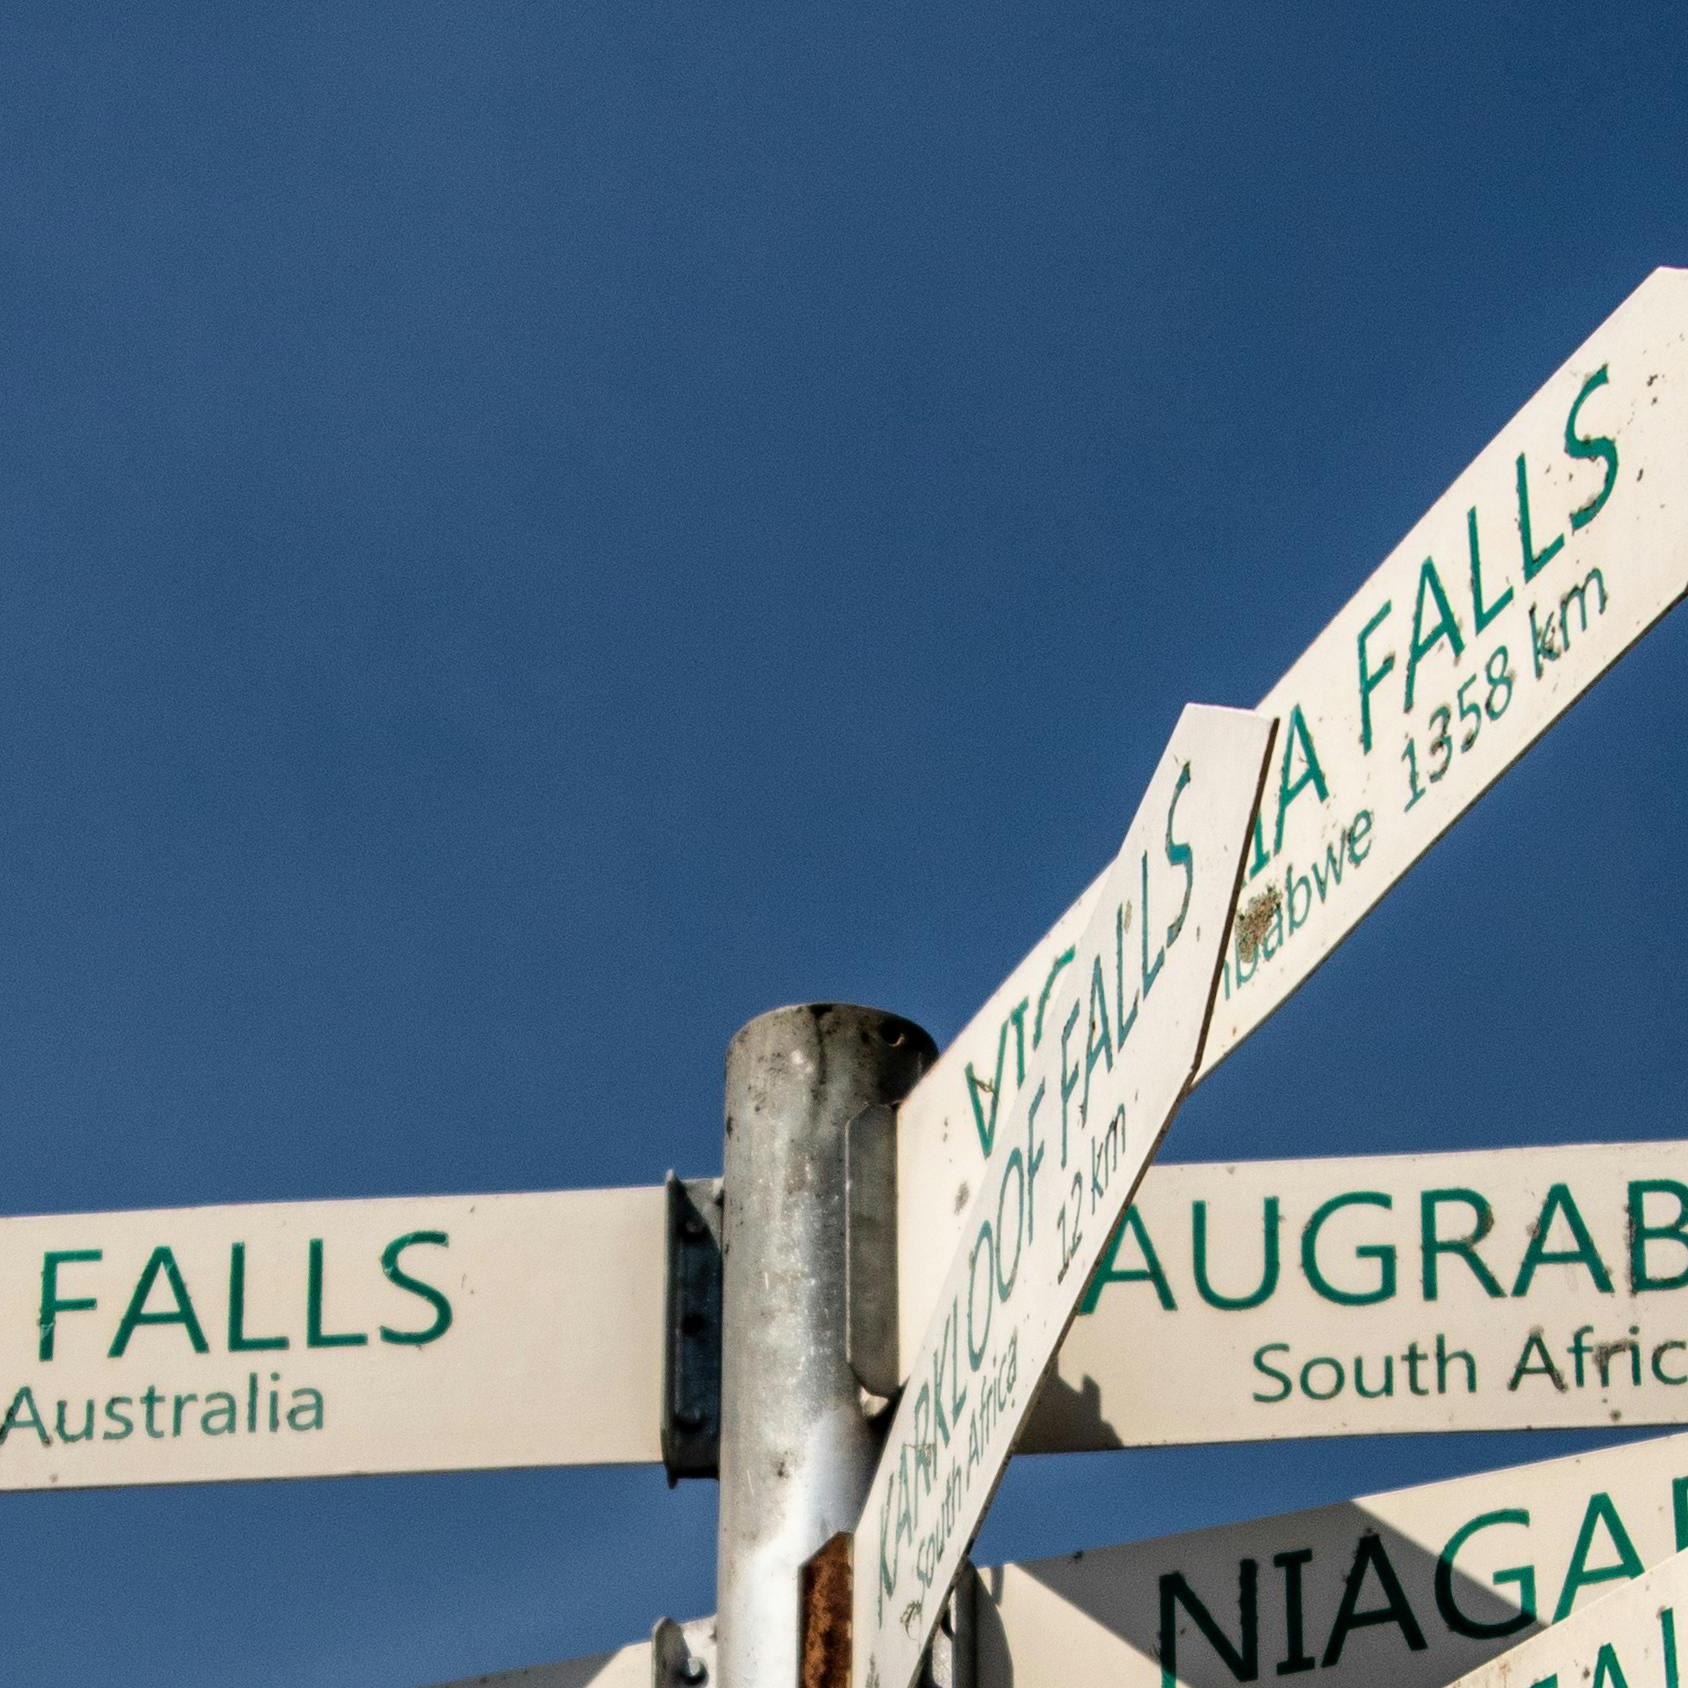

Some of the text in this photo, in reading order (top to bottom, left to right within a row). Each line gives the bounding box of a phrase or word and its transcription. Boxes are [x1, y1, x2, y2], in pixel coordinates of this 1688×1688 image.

[1355, 363, 1621, 755] FALLS
[1223, 567, 1608, 1000] babwe 1358 km
[41, 1229, 456, 1362] FALLS
[878, 760, 1193, 1630] KARKLOOF FALLS
[916, 1102, 1125, 1632] South Africa 12 km
[1251, 1333, 1479, 1405] South
